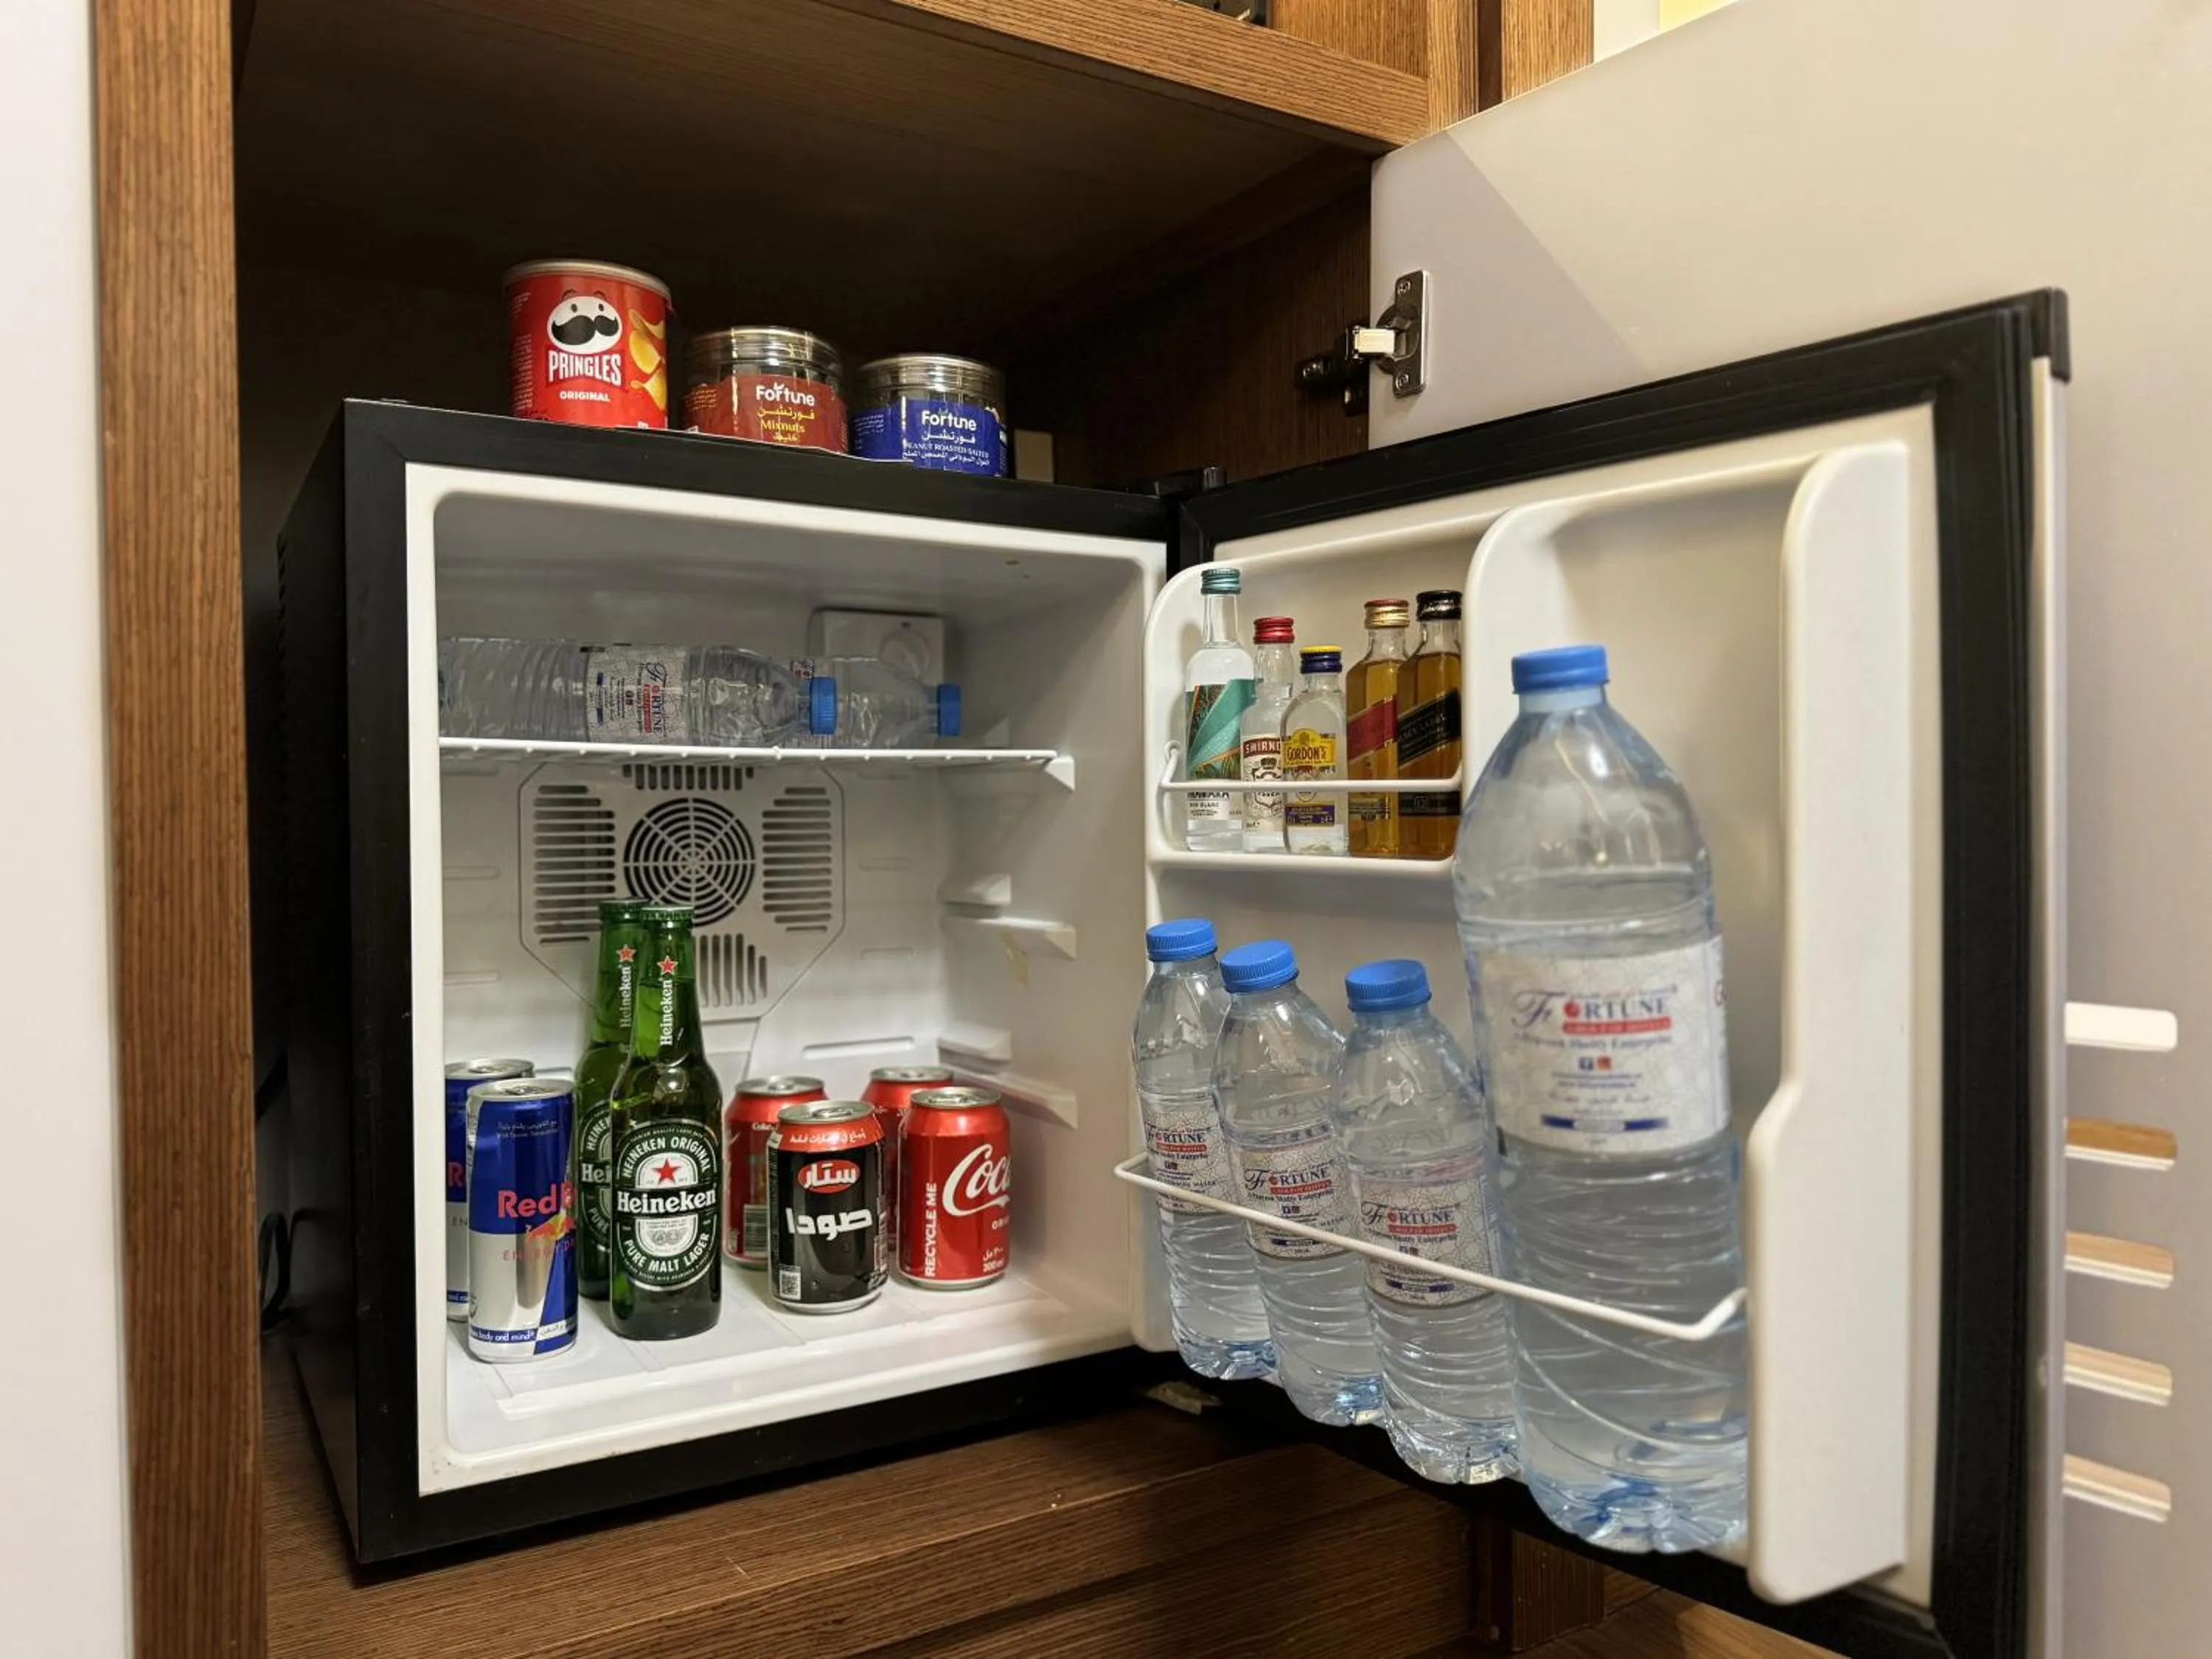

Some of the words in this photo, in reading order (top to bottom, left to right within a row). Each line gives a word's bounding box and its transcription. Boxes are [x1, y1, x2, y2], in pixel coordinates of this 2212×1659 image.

[548, 350, 622, 386] PRINGLES
[559, 390, 611, 403] ORIGINAL
[756, 382, 815, 406] Fortune
[760, 418, 806, 434] Mixnuts
[922, 410, 977, 431] Fortune
[1287, 745, 1326, 760] GORDON'S
[619, 965, 632, 1028] Heineken
[661, 979, 673, 1046] Heineken
[622, 1137, 666, 1179] HEINEKEN
[670, 1135, 712, 1174] ORIGINAL
[803, 1163, 857, 1189] ستار
[498, 1182, 557, 1219] Red
[616, 1189, 717, 1214] Heineken
[925, 1182, 938, 1206] ME
[785, 1207, 873, 1241] صودا
[624, 1239, 647, 1268] PURE
[647, 1259, 680, 1273] MALT
[683, 1232, 710, 1267] LAGER
[925, 1208, 938, 1277] RECYCLE
[495, 1332, 509, 1340] and
